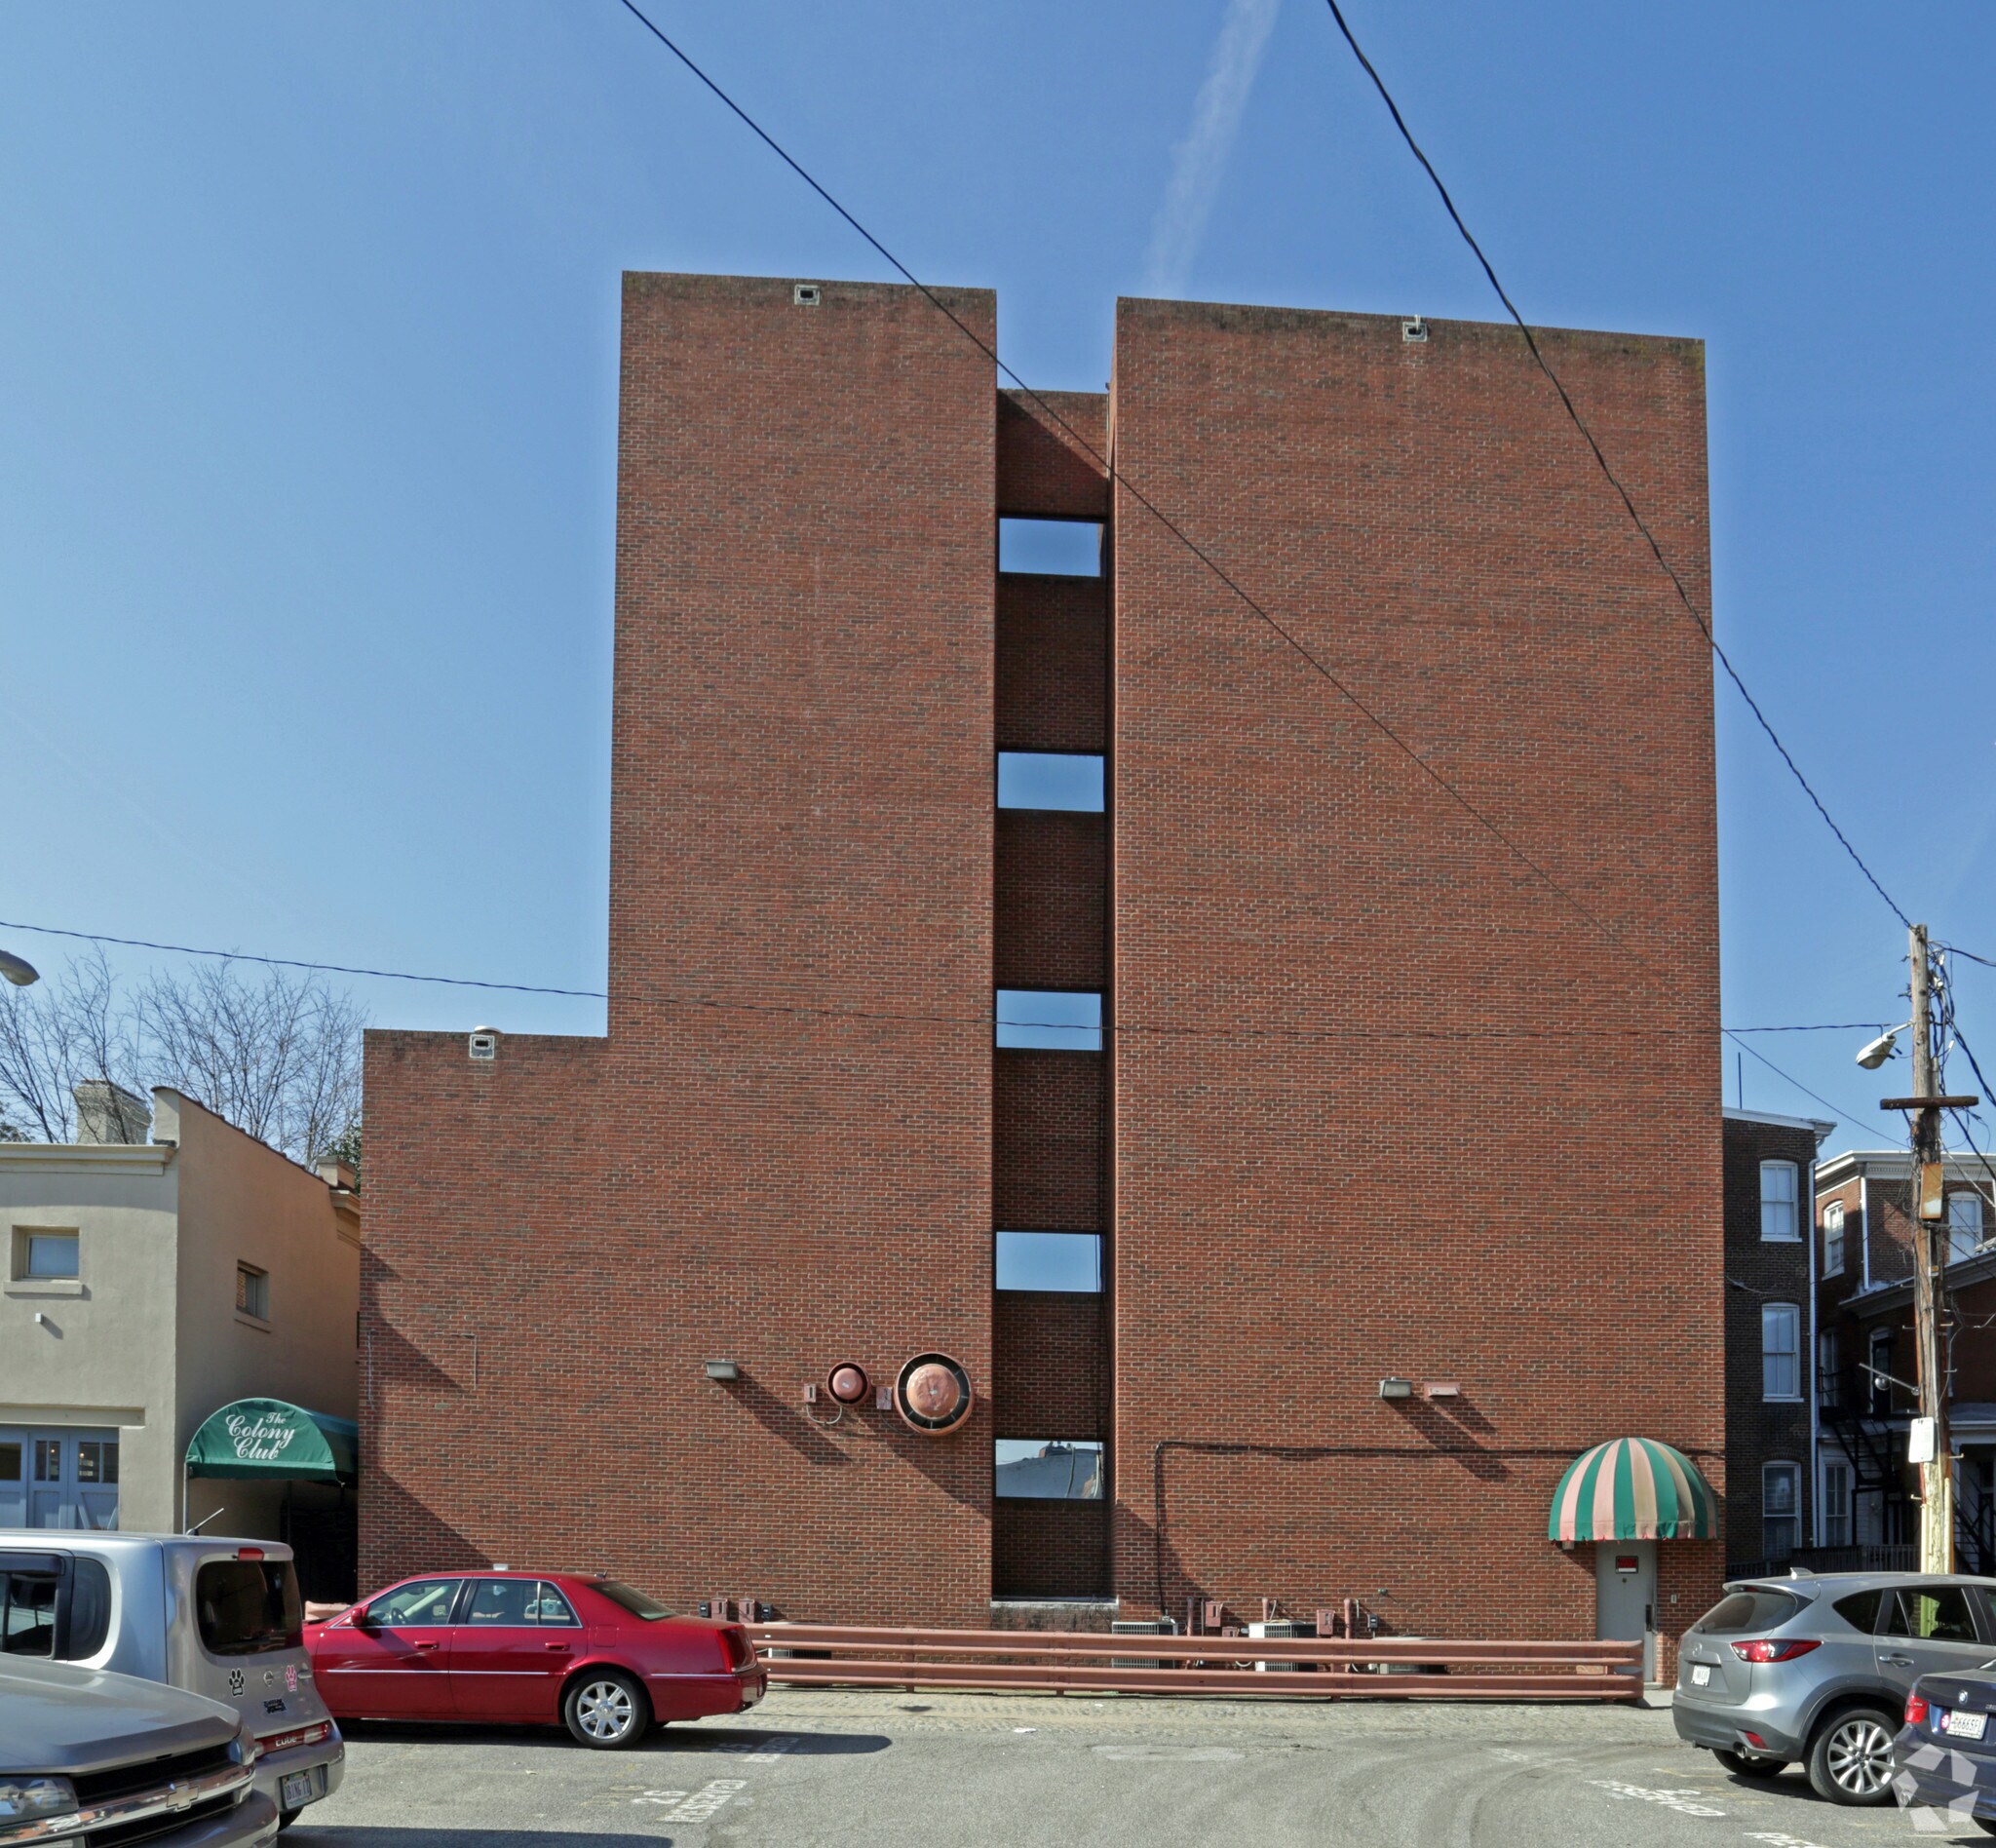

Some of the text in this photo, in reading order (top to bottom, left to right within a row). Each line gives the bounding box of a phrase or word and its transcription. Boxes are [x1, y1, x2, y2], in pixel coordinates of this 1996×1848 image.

[225, 1414, 296, 1449] Colony
[265, 1412, 287, 1425] The
[234, 1436, 280, 1460] Club
[660, 1779, 748, 1824] RESERVED
